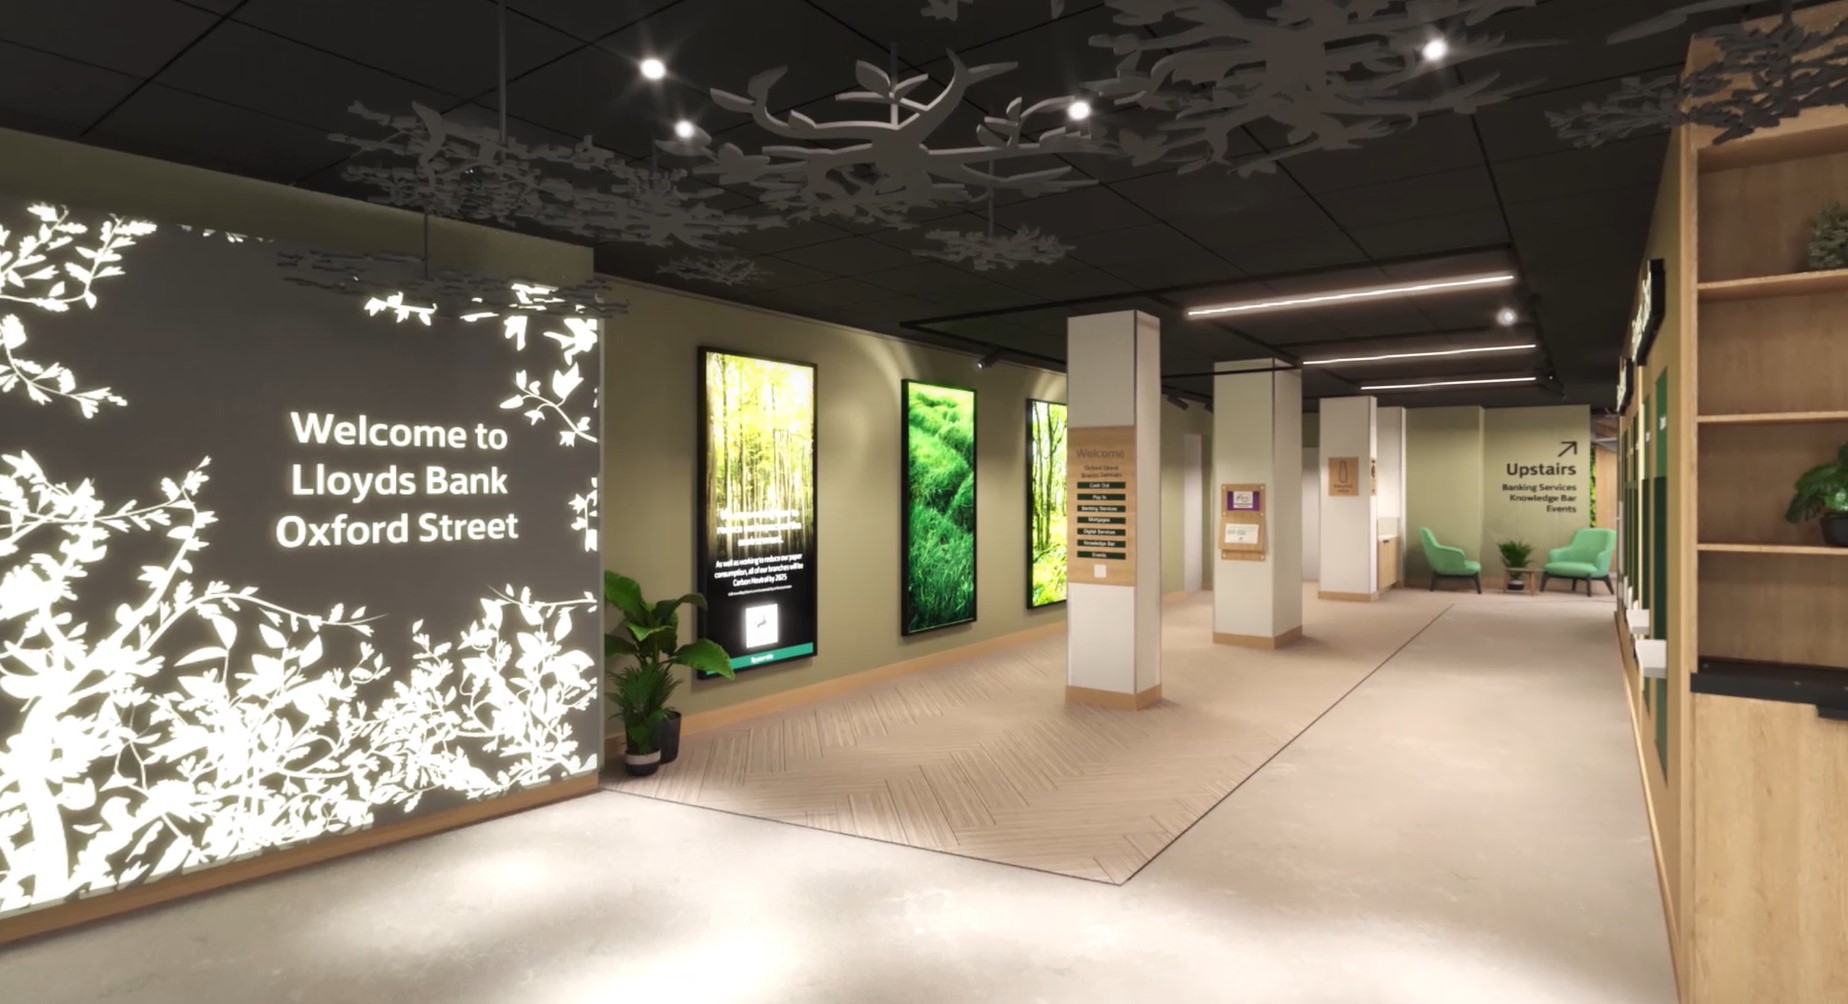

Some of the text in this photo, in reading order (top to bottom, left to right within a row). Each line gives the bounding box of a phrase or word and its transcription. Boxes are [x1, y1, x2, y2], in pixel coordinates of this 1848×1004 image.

[290, 411, 508, 450] Welcome to
[1076, 448, 1125, 458] Welcome
[1506, 462, 1577, 478] Upstairs
[292, 463, 508, 504] Lloyds Bank
[1502, 483, 1577, 493] Banking Services
[1509, 494, 1559, 503] Knowledge
[1546, 504, 1577, 513] Events
[275, 512, 519, 548] Oxford Street
[715, 560, 723, 568] As
[723, 558, 733, 567] well
[789, 553, 803, 562] paper
[714, 568, 748, 579] consumption,
[768, 564, 789, 572] branches
[733, 578, 751, 587] Carbon
[775, 573, 788, 581] 2025
